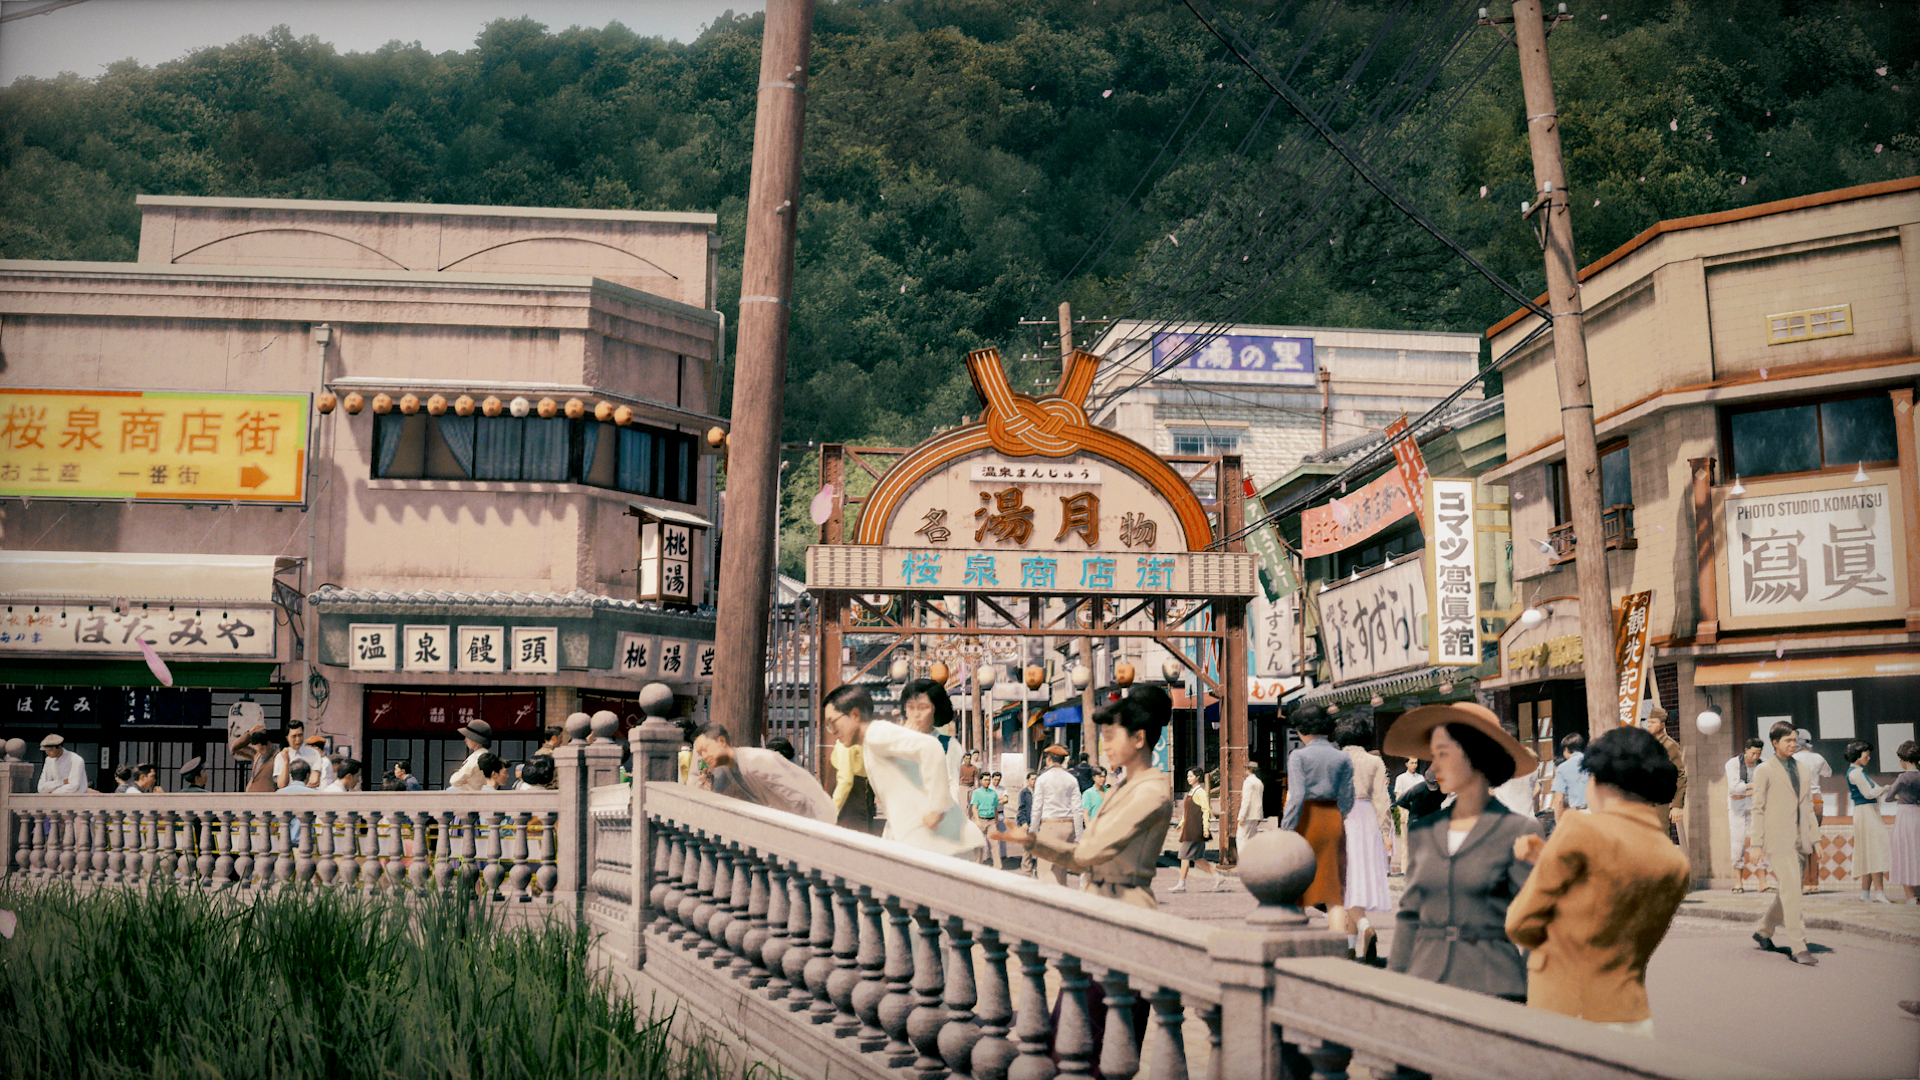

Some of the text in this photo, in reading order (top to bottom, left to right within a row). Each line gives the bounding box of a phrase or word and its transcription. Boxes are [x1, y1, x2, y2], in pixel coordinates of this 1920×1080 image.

[1, 404, 281, 455] 桜泉商店街
[1, 462, 200, 485] お土産 一番街
[981, 466, 1090, 480] 温泉まんじゅう
[1737, 503, 1775, 520] PHOTO
[665, 529, 687, 595] 桃湯
[901, 552, 1175, 589] 桜泉商店街
[74, 617, 255, 648] ほたみや
[358, 633, 548, 665] 温泉饅頭
[624, 641, 714, 677] 桃湯堂
[1619, 606, 1646, 724] 観光記念
[17, 696, 91, 712] ほたみ
